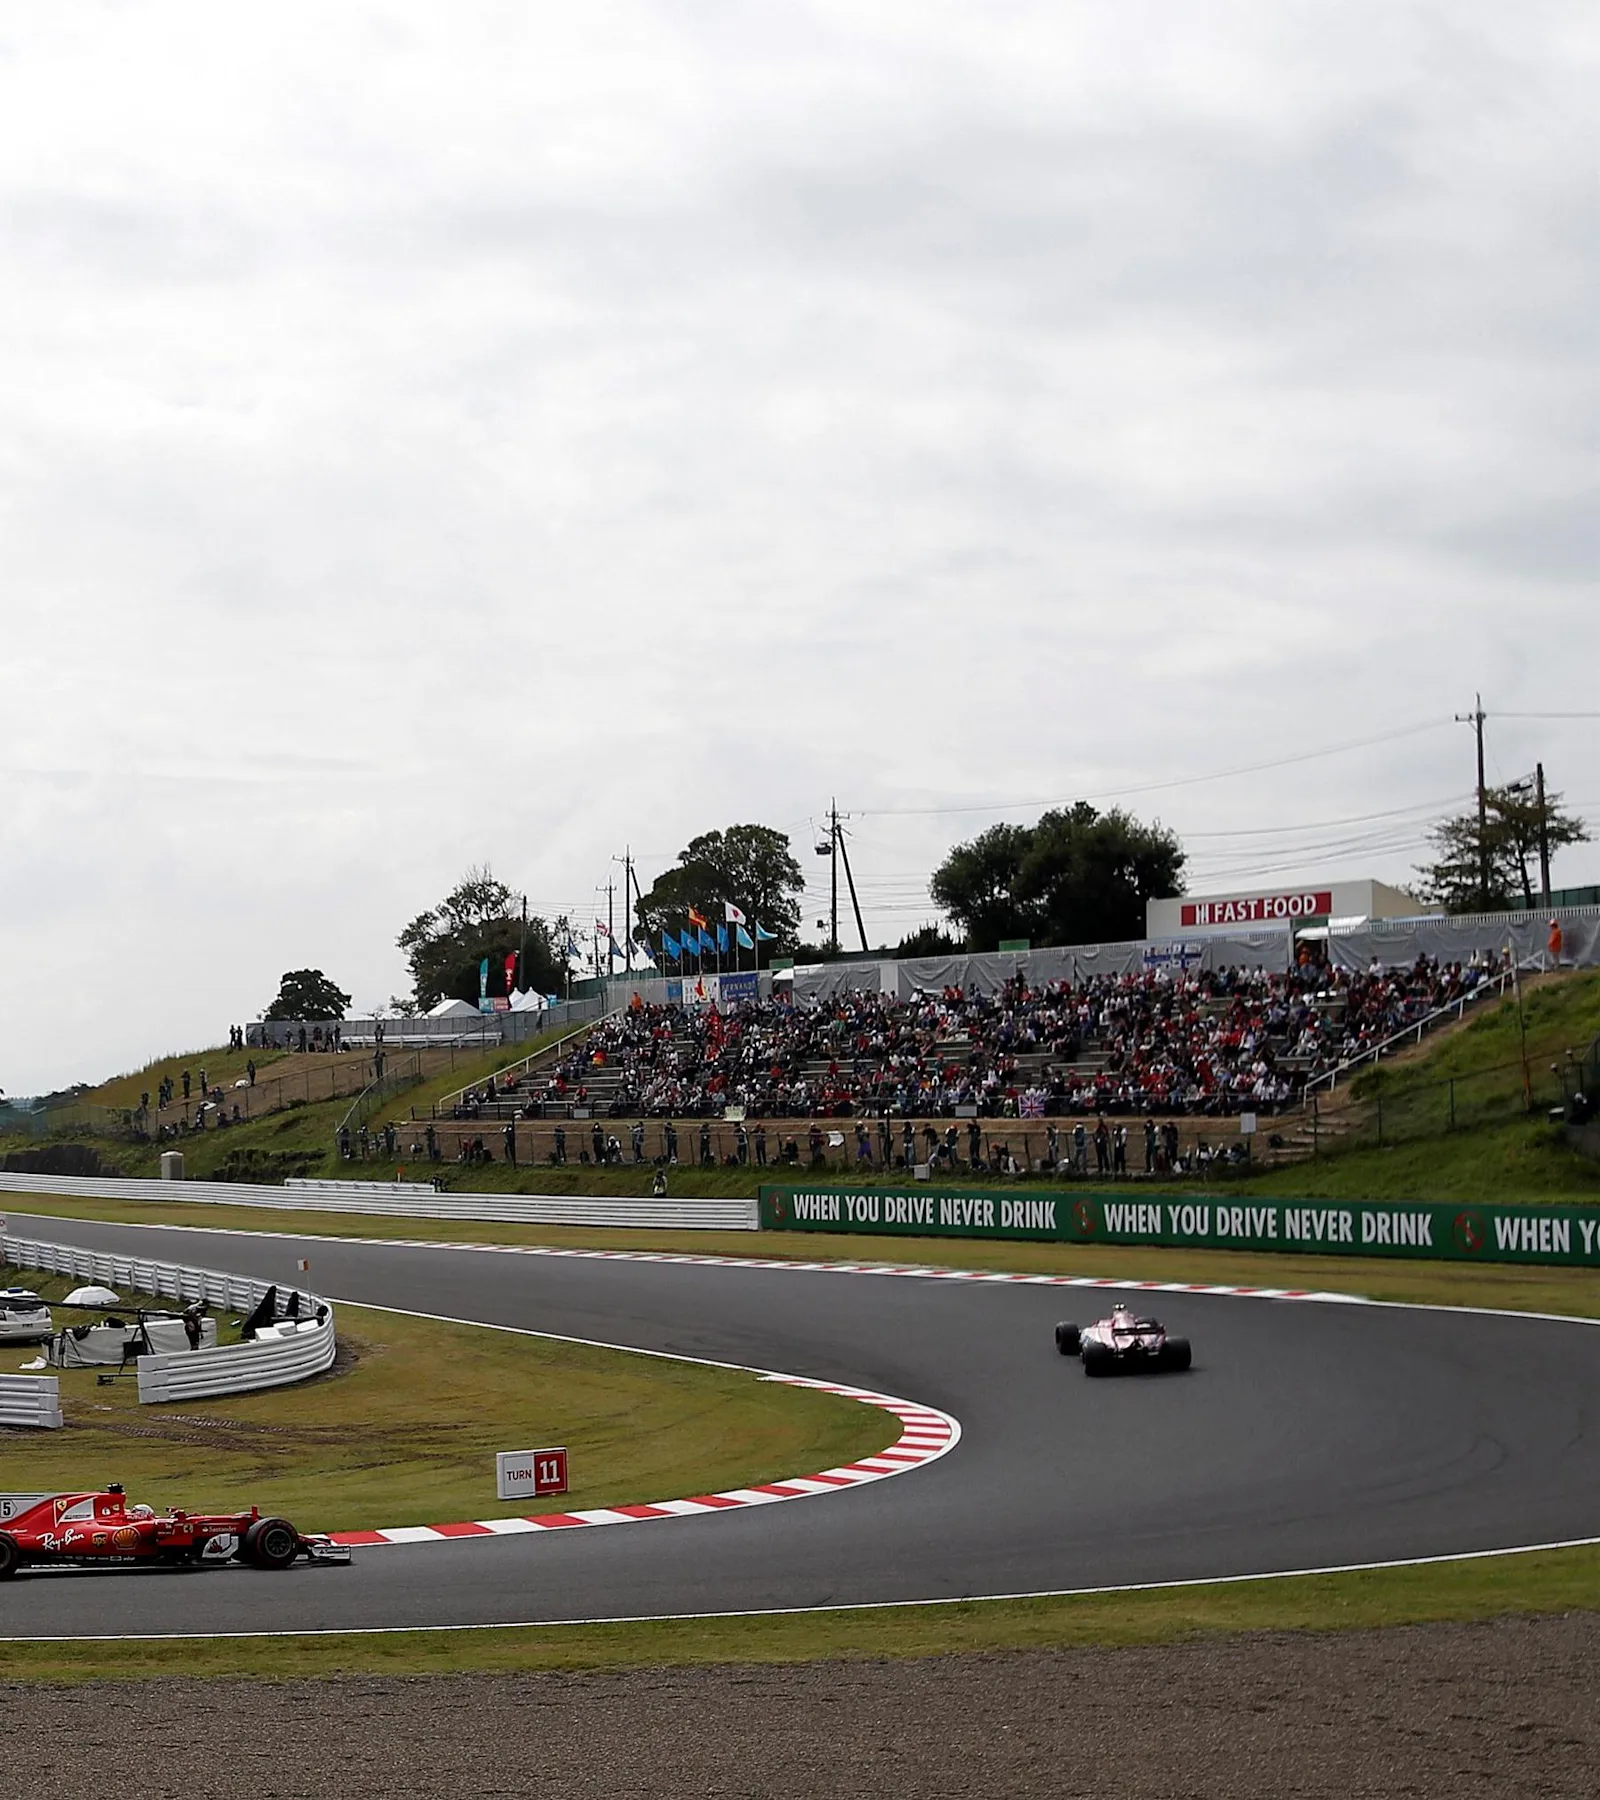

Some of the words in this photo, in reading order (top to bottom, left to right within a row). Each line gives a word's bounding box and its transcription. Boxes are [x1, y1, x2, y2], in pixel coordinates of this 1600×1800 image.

[1214, 900, 1258, 923] FAST
[1263, 894, 1317, 918] FOOD
[793, 1194, 840, 1221] WHEN
[845, 1195, 879, 1222] YOU
[884, 1196, 934, 1224] DRIVE
[940, 1198, 994, 1227] NEVER
[1001, 1200, 1057, 1229] DRINK
[1103, 1203, 1162, 1234] WHEN
[1167, 1204, 1209, 1236] YOU
[1216, 1206, 1277, 1239] DRIVE
[1285, 1207, 1353, 1242] NEVER
[1361, 1211, 1433, 1246] DRINK
[1494, 1216, 1570, 1253] WHEN
[1578, 1219, 1600, 1254] Y
[506, 1469, 532, 1481] TURN
[539, 1459, 560, 1484] 11
[2, 1501, 11, 1516] 5
[208, 1525, 237, 1533] Santander
